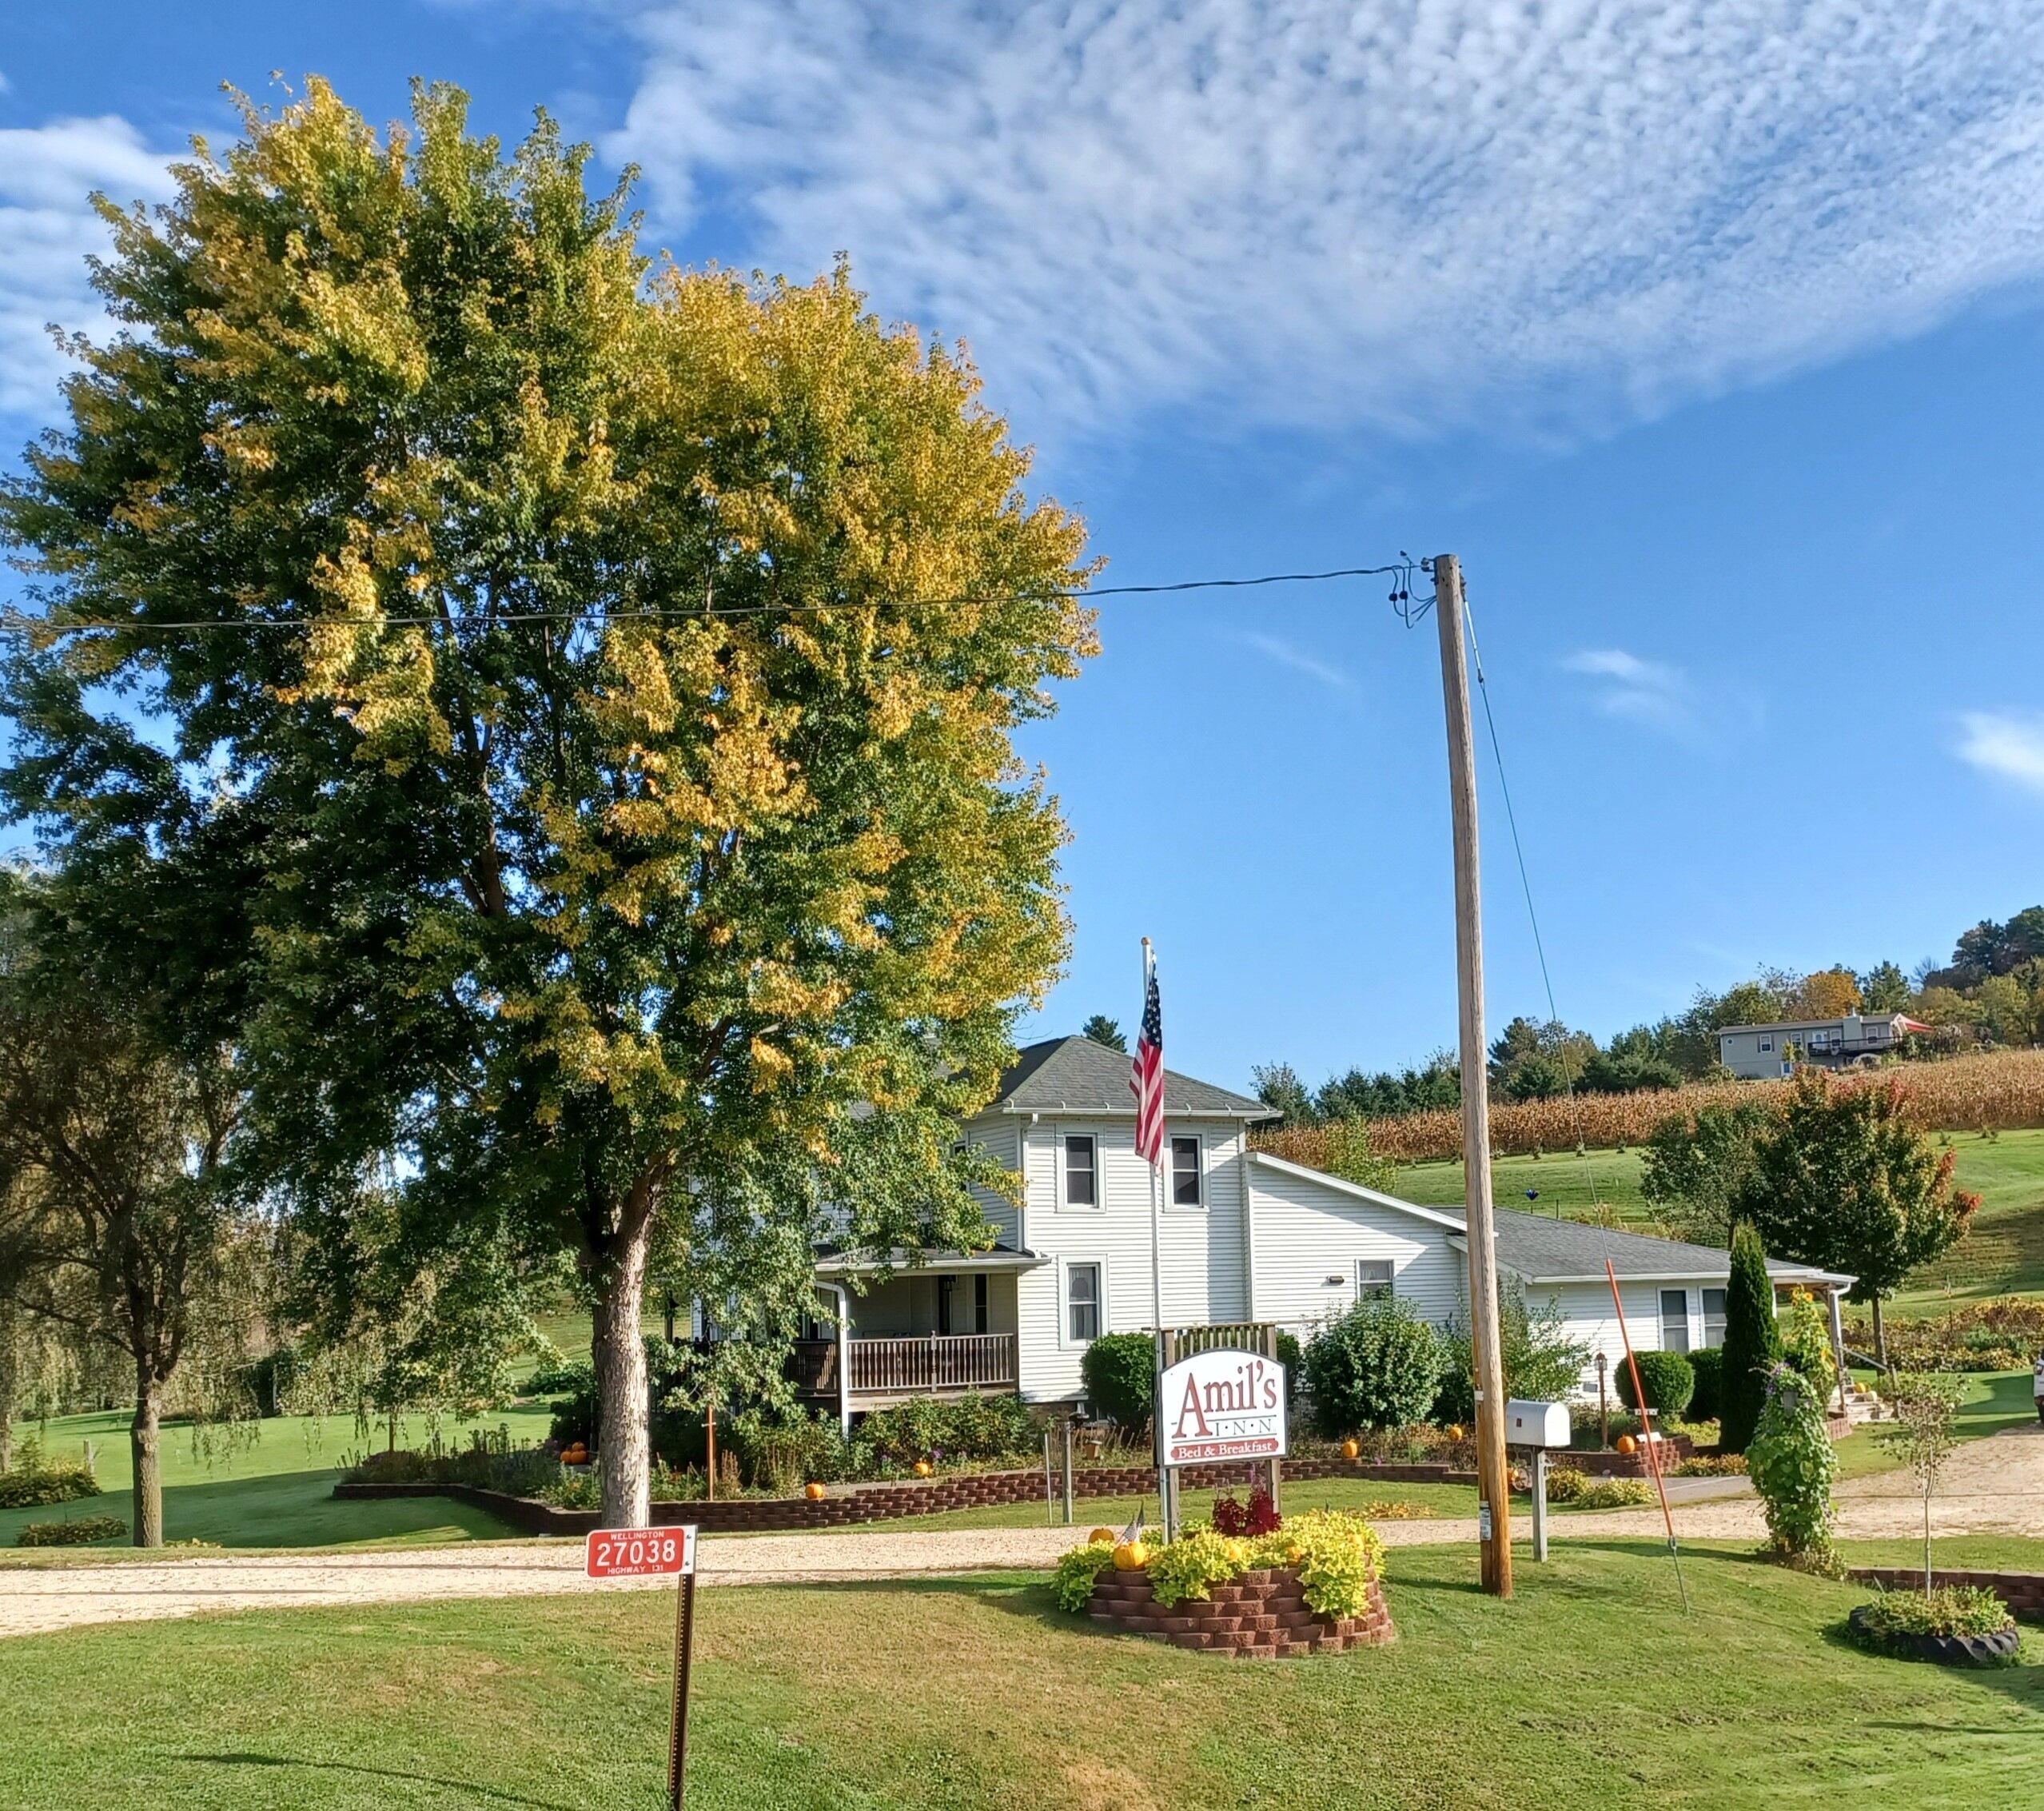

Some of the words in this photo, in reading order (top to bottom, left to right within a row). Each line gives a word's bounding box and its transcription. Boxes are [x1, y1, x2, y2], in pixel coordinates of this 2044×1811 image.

[1171, 1360, 1277, 1439] Amil's
[1178, 1446, 1201, 1458] Bed
[1204, 1446, 1216, 1457] &
[1219, 1441, 1273, 1454] Breakfast
[610, 1530, 664, 1541] WELLINGTON
[596, 1539, 675, 1567] 27038
[608, 1566, 645, 1574] HIGHWAY
